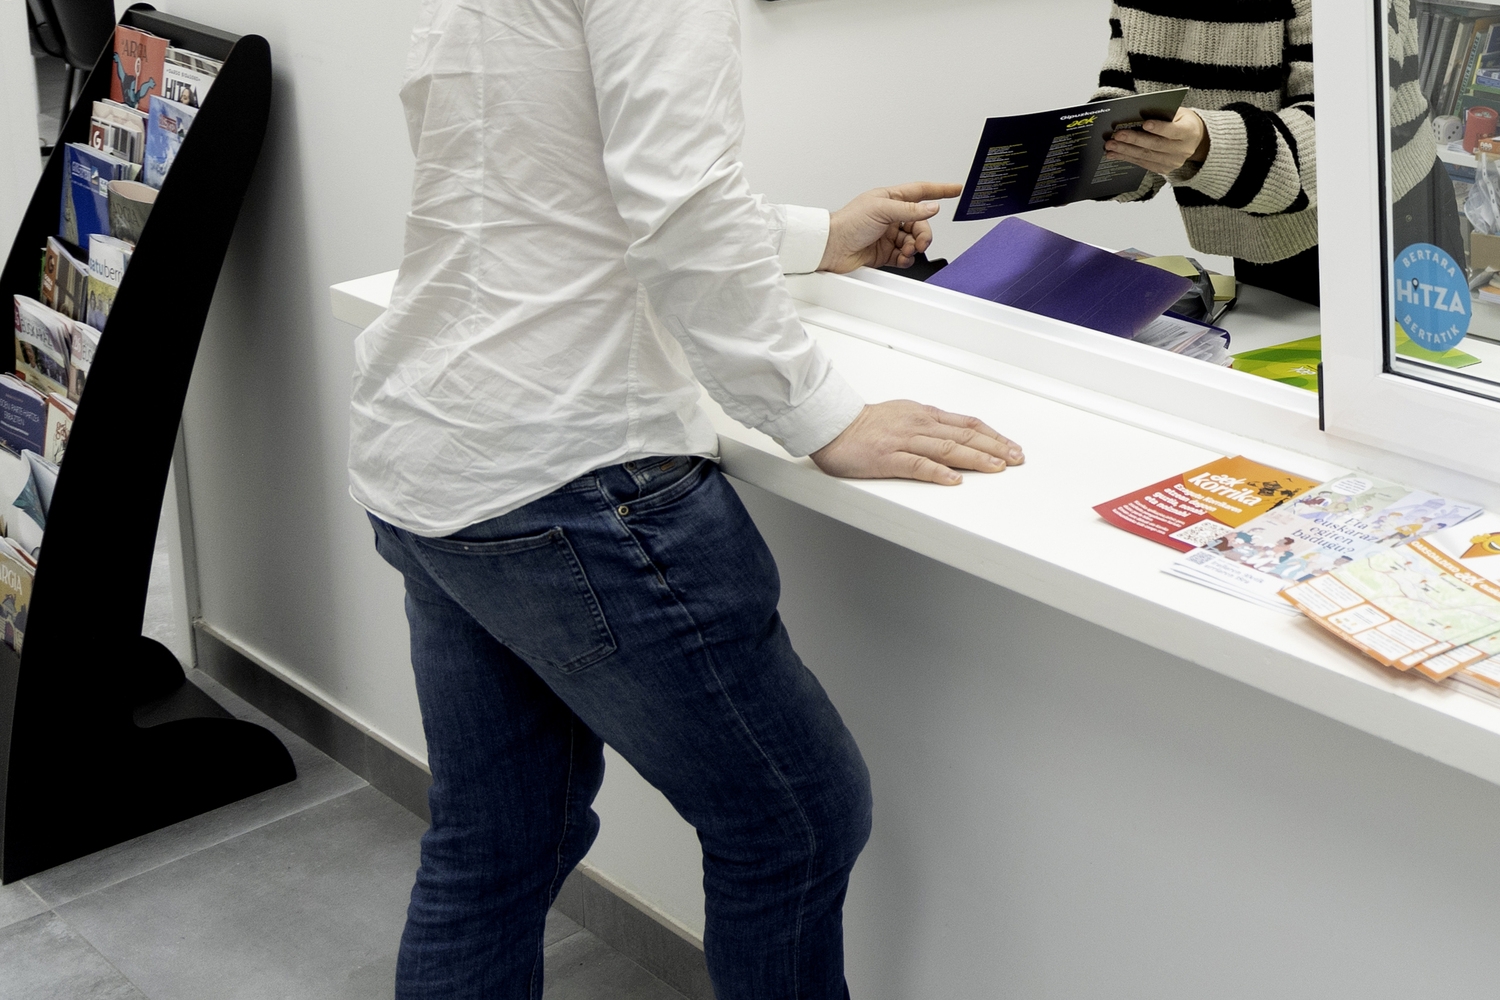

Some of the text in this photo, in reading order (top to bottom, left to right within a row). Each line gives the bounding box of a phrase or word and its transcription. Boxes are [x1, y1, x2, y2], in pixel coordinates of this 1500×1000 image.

[1402, 249, 1456, 278] BERTARA
[1403, 314, 1460, 344] BERTATIK
[1187, 472, 1262, 506] korrika
[1210, 474, 1247, 488] aek
[1309, 525, 1354, 545] egiten
[1313, 516, 1379, 543] euskaraz
[1344, 517, 1369, 530] Eta
[1291, 528, 1356, 554] badugu?
[1411, 539, 1461, 574] OARSOALDEKO
